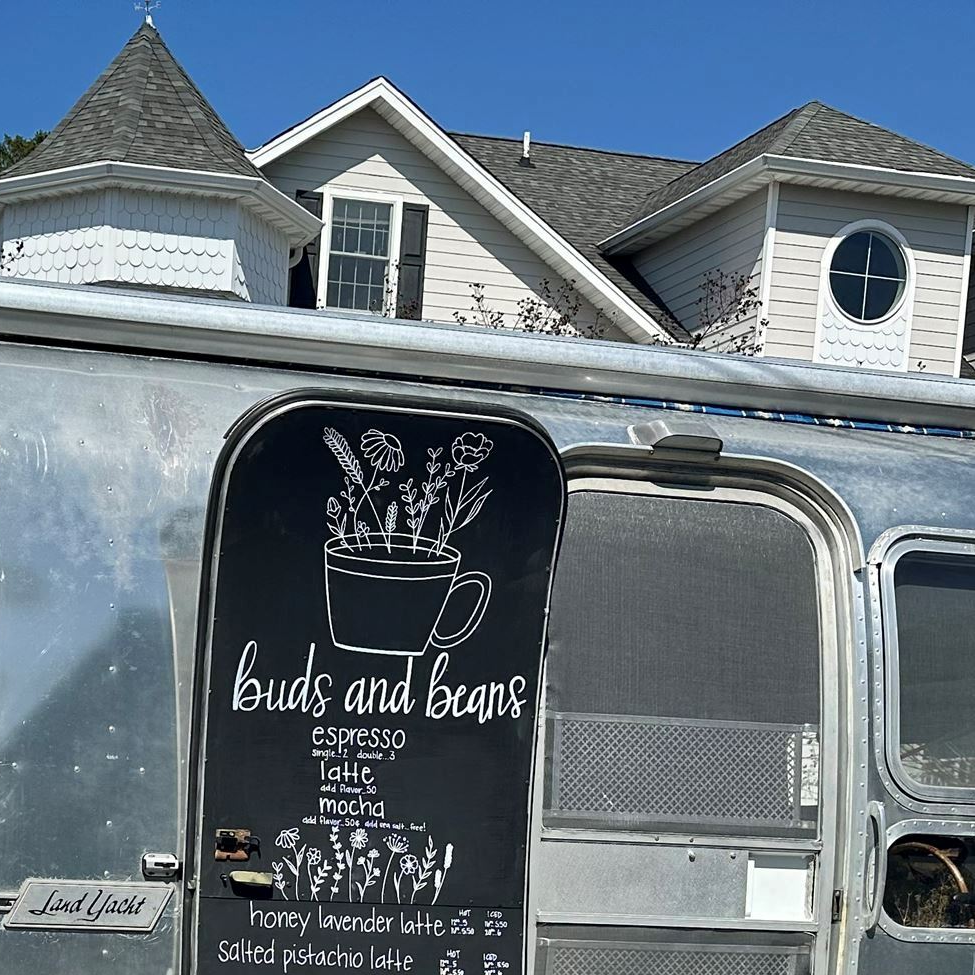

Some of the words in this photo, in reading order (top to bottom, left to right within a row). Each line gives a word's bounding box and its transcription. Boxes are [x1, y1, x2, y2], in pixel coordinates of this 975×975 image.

[231, 640, 332, 718] buds
[343, 655, 417, 716] and
[425, 651, 527, 724] beans
[312, 726, 406, 754] espresso
[320, 760, 375, 784] latte
[320, 783, 336, 793] add
[319, 795, 385, 819] mocha
[302, 815, 317, 825] add
[28, 889, 89, 916] Land
[76, 889, 147, 922] Yacht
[459, 909, 471, 917] HOT
[249, 900, 311, 937] honey
[319, 905, 394, 933] lavender
[400, 910, 446, 937] latte
[283, 943, 363, 973] pistachio
[370, 945, 413, 972] latte
[446, 949, 461, 959] HOT
